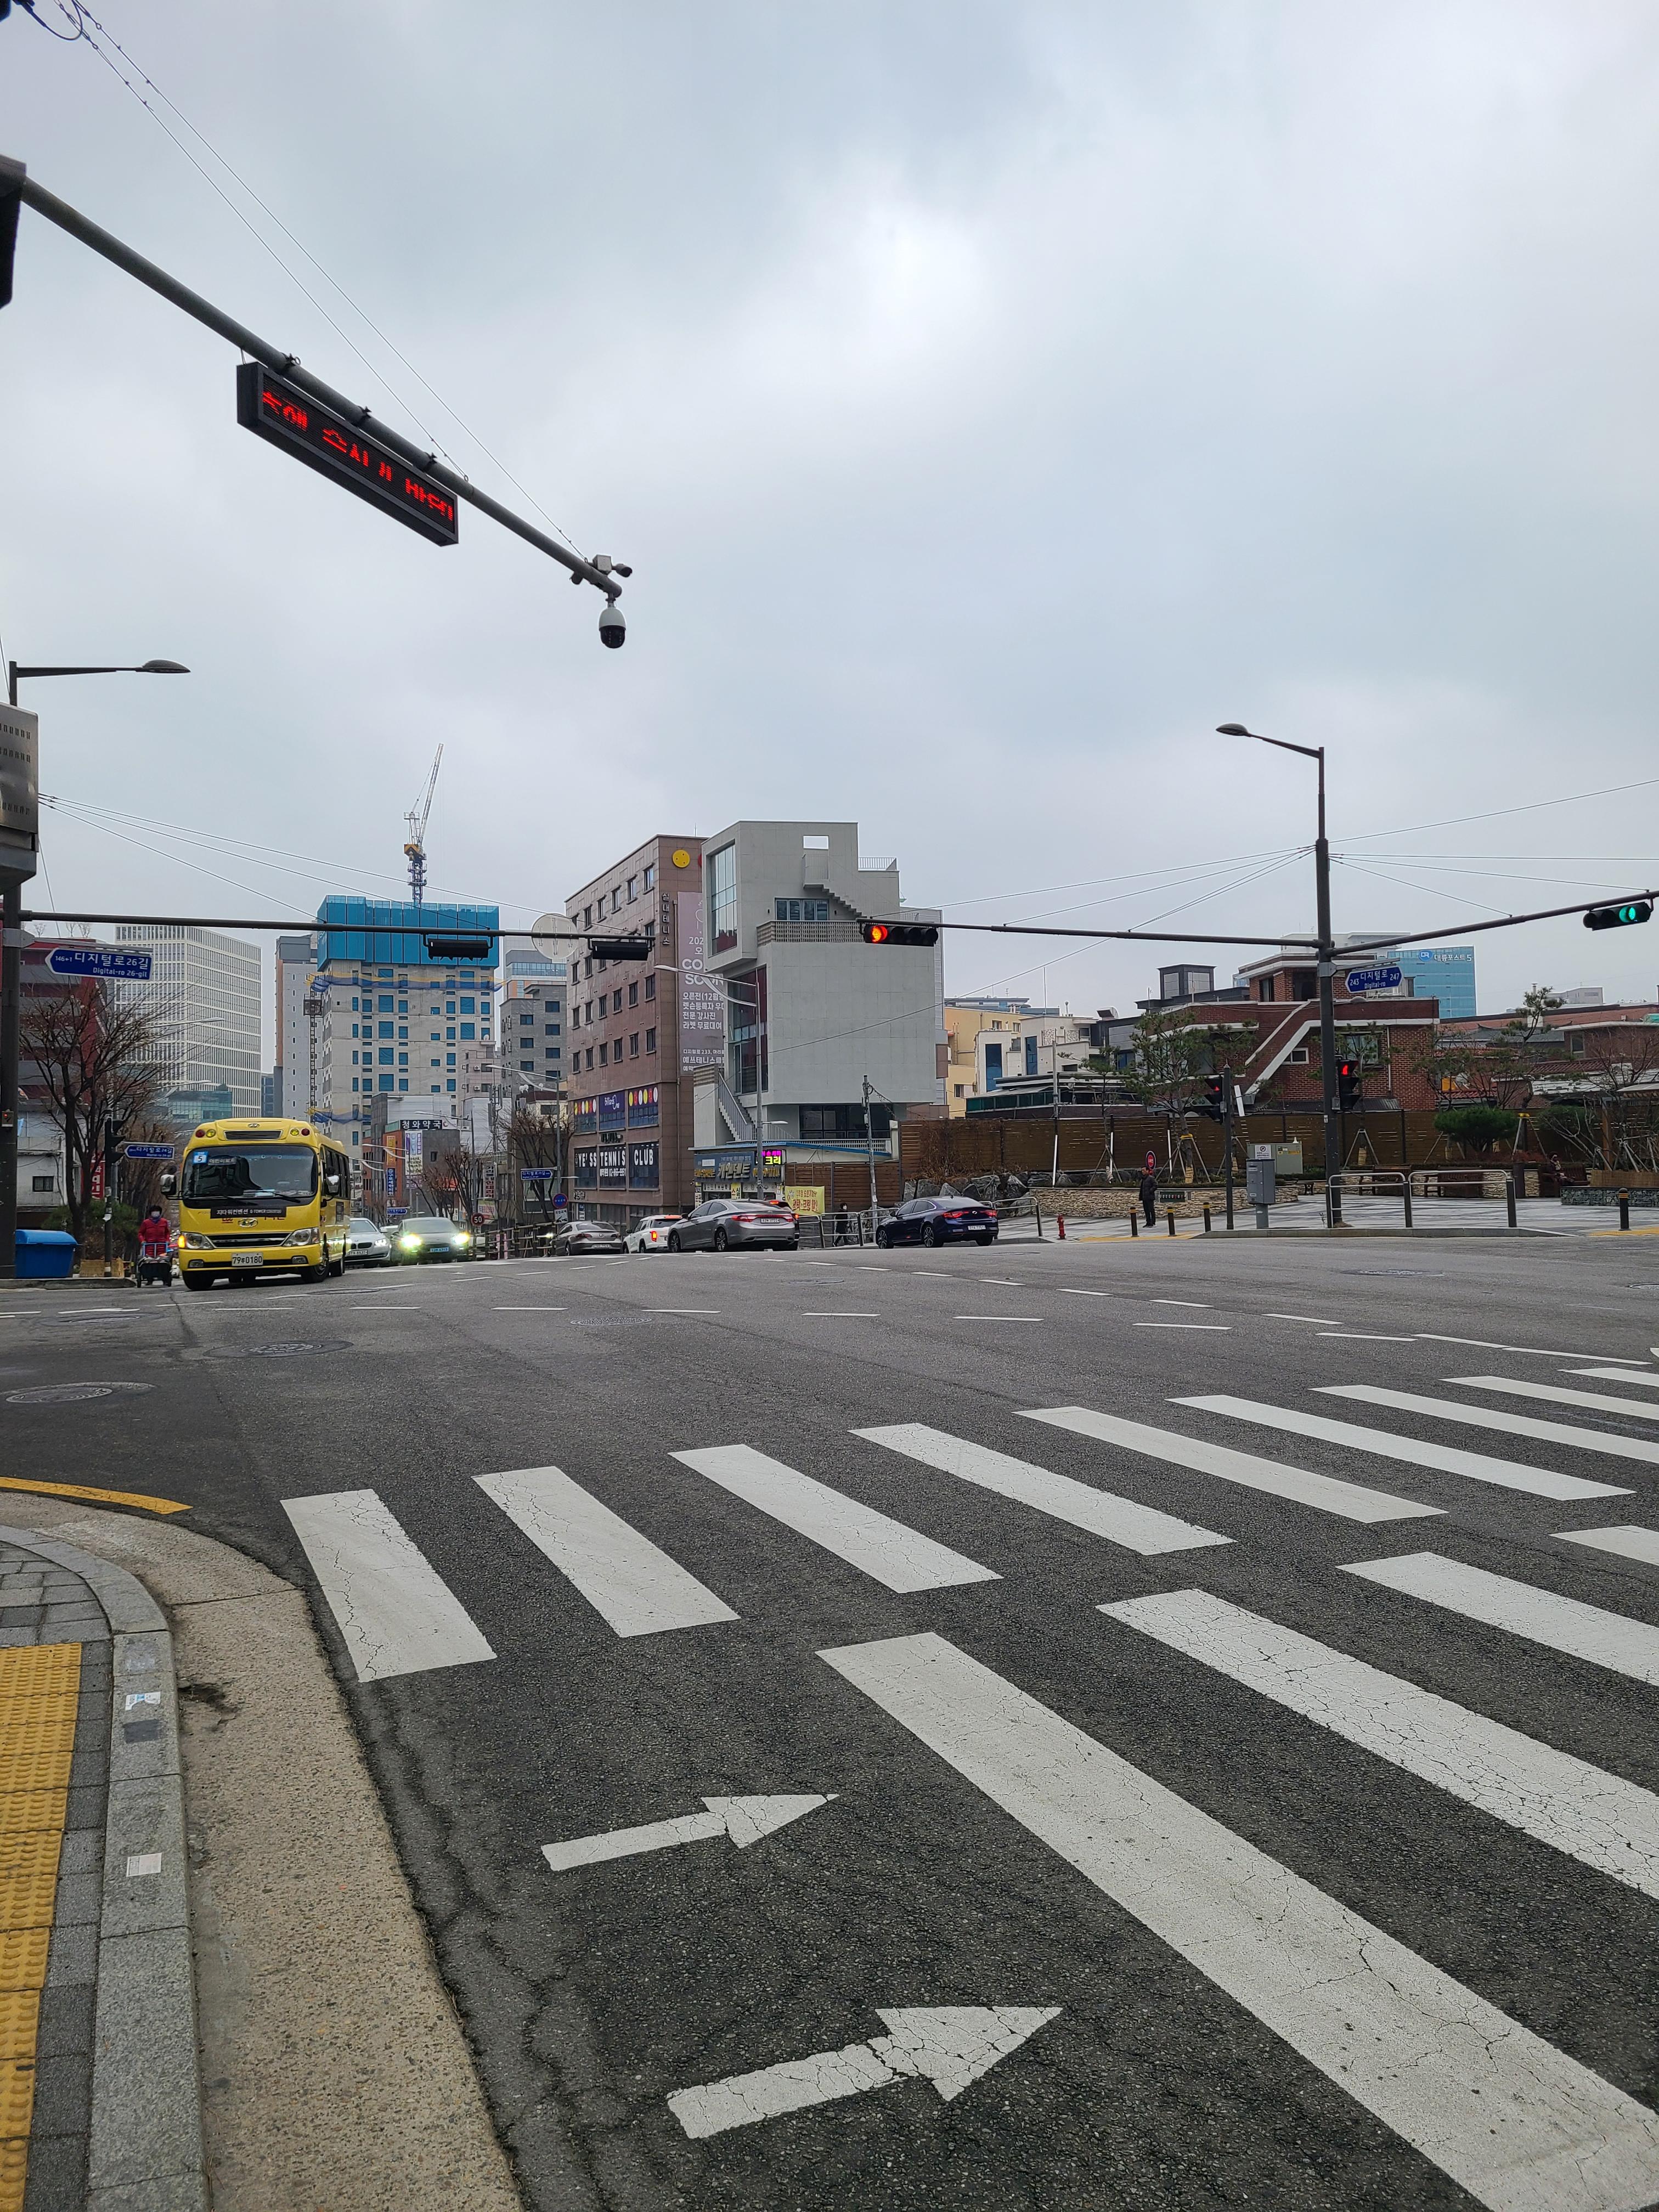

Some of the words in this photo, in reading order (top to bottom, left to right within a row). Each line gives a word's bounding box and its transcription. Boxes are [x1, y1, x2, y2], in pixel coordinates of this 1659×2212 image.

[689, 936, 703, 945] 202
[75, 952, 149, 969] 디지털로26길
[682, 958, 703, 970] CO
[93, 967, 125, 975] Digital-ro
[1360, 969, 1388, 981] 디지털로
[1390, 973, 1399, 981] 247
[685, 973, 724, 986] SON
[682, 1012, 696, 1020] 전문
[697, 1012, 715, 1020] 강사진
[682, 1021, 696, 1029] 라켓
[697, 1022, 721, 1030] 무료대여
[402, 1120, 441, 1129] 청와약국
[600, 1150, 625, 1167] TENNIS
[634, 1149, 653, 1166] CLUB
